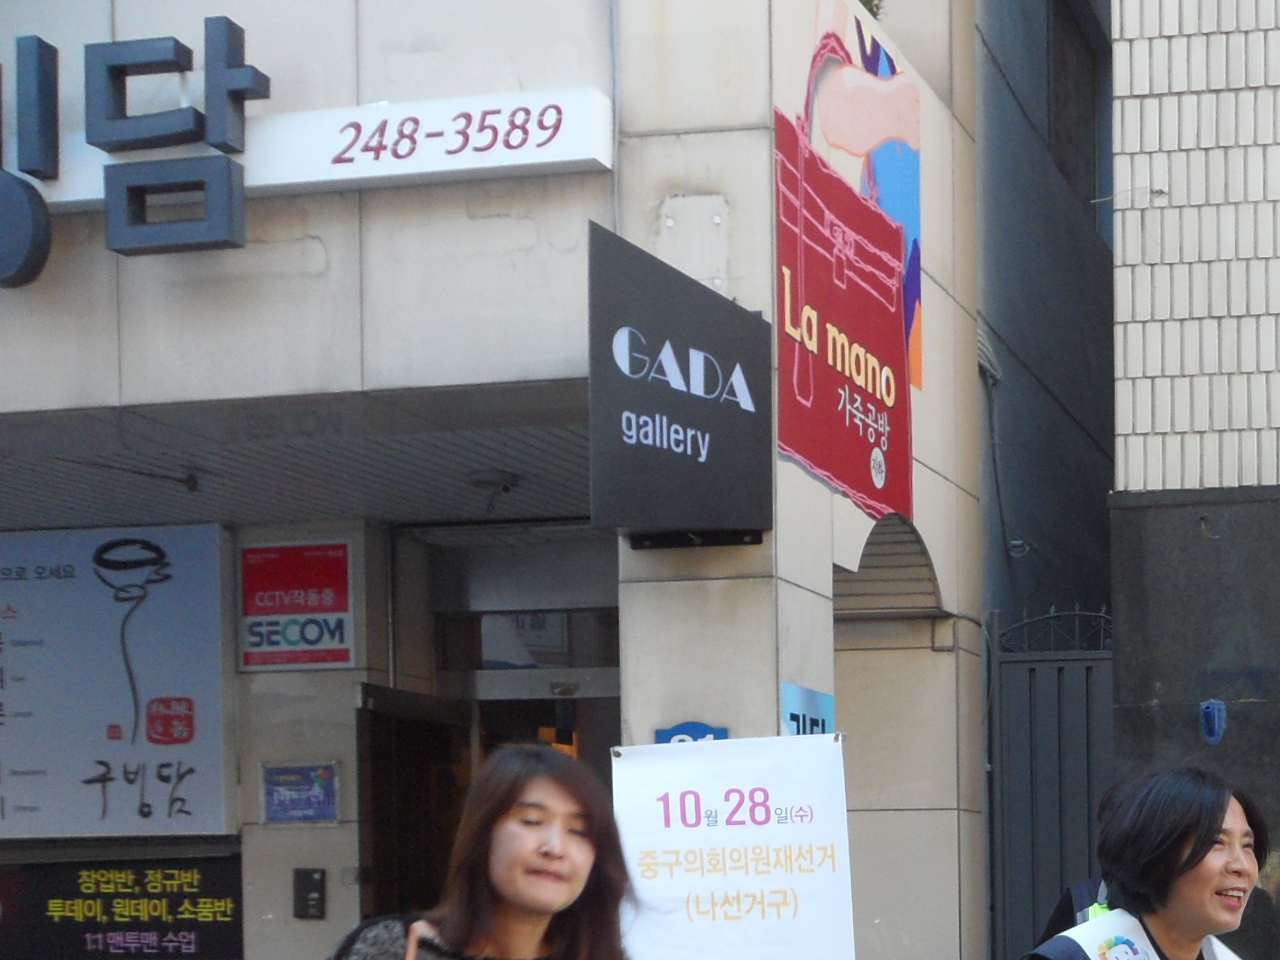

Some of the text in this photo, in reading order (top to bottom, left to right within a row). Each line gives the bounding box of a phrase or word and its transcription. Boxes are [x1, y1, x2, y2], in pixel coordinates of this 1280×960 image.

[331, 103, 564, 165] 248-3589
[781, 265, 896, 408] La mano
[612, 326, 756, 413] GADA
[621, 410, 710, 463] gallery
[837, 383, 891, 452] 가죽공방
[247, 618, 345, 647] SECOM
[656, 786, 814, 828] 10월 28일(수)
[637, 843, 838, 880] 중구의회의원재선거
[78, 869, 202, 894] 창업반, 정규반
[46, 897, 235, 923] 투데이, 원데이, 소품반
[685, 887, 799, 922] (나선거구)
[106, 931, 160, 953] 맨투맨
[161, 930, 197, 953] 수업
